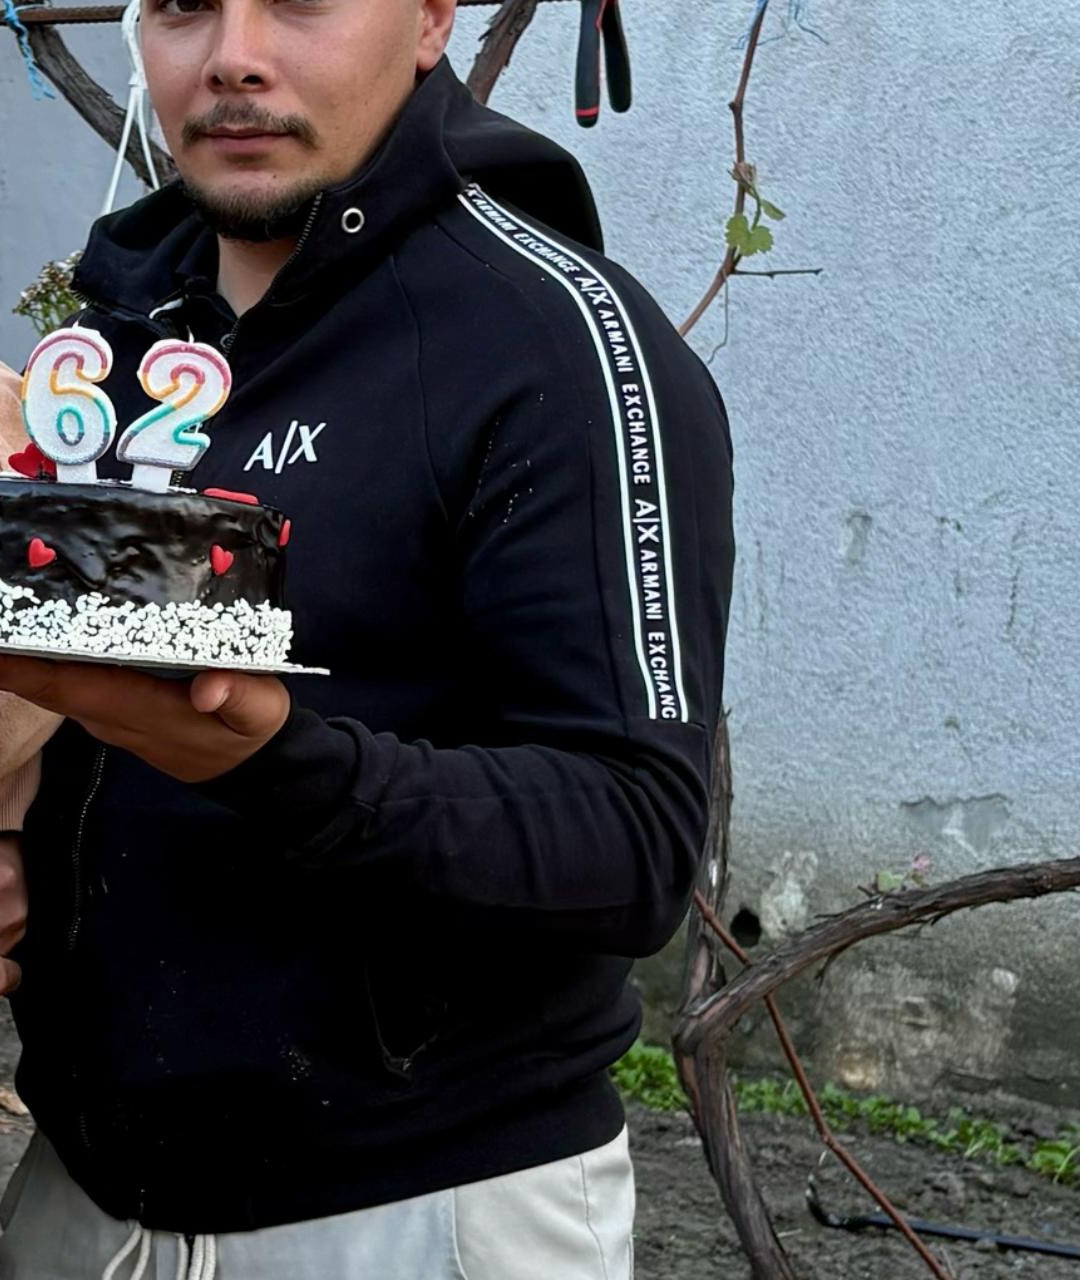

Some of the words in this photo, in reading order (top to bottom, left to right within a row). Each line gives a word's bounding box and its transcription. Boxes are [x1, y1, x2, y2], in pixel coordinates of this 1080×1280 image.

[21, 326, 232, 472] 62
[513, 232, 580, 273] EXCHANGE
[597, 308, 634, 373] ARMANI
[621, 383, 651, 485] EXCHANGE
[640, 549, 663, 620] ARMANI
